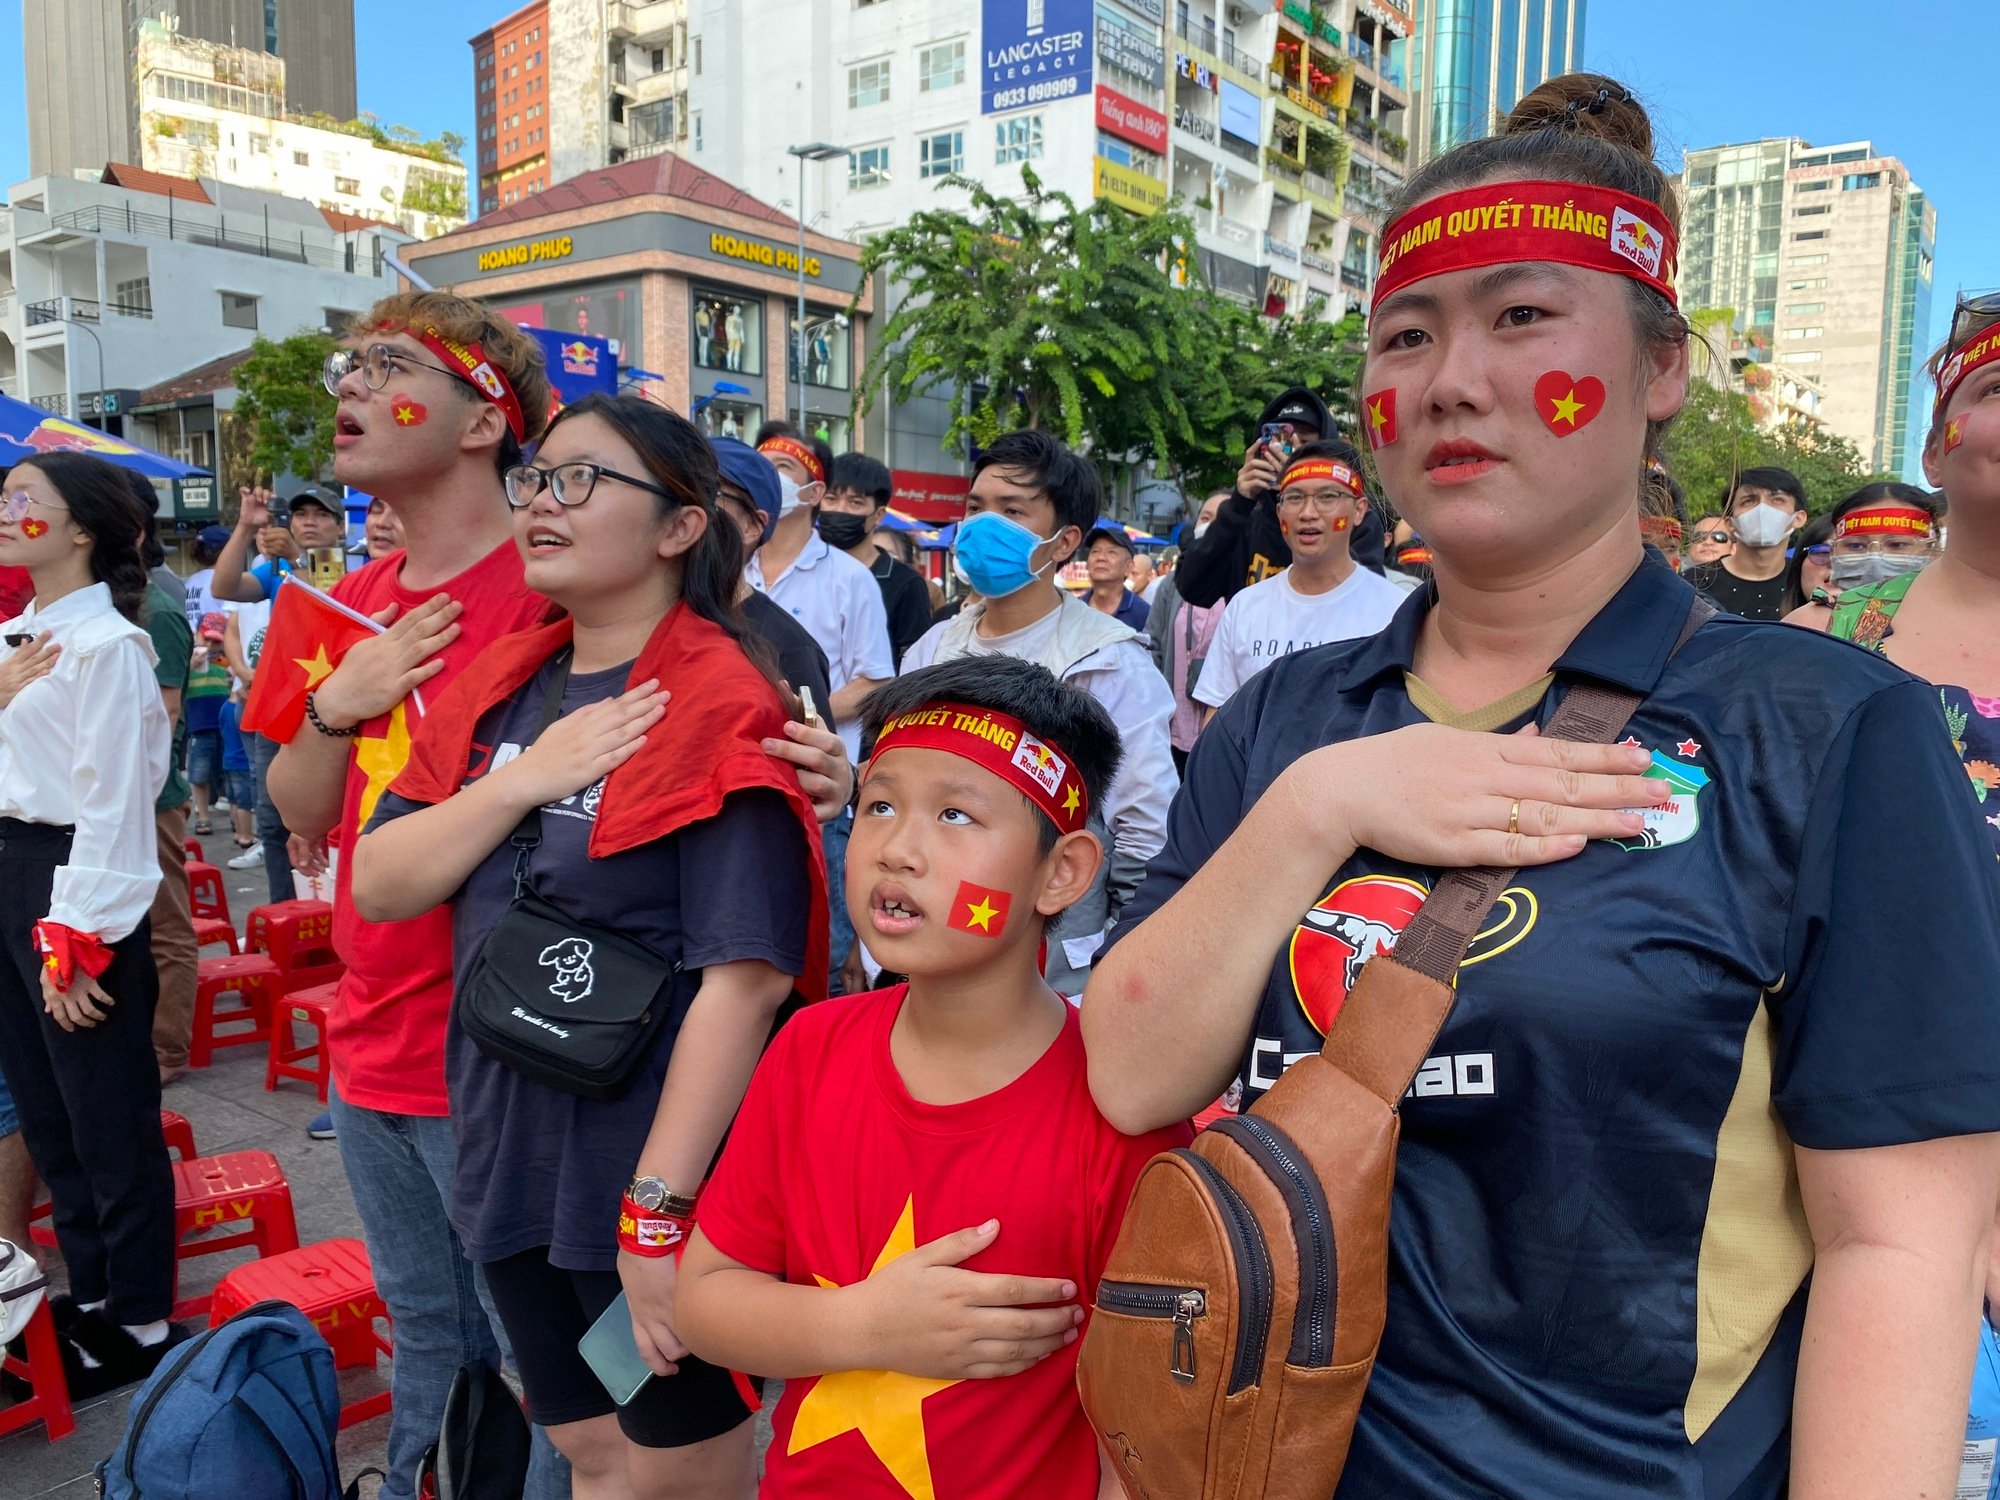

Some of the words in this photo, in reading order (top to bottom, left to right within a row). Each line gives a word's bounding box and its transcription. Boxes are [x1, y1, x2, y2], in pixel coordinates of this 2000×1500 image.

[987, 31, 1084, 69] LANCASTER
[993, 54, 1077, 82] LEGACY
[993, 86, 1026, 110] 0933
[1027, 76, 1078, 103] 090909
[1398, 215, 1443, 259] NAM
[1446, 198, 1525, 237] QUYẾT
[1529, 199, 1608, 240] THẮNG
[478, 243, 529, 271] HOANG
[530, 234, 573, 261] PHUC
[711, 231, 774, 268] HOANG
[1618, 238, 1638, 261] Red
[1636, 248, 1655, 274] Bull
[1859, 516, 1881, 527] NAM
[1882, 515, 1911, 528] QUYẾT
[897, 705, 953, 729] QUYẾT
[951, 713, 1018, 753] THẮNG
[1019, 754, 1039, 776] Red
[1036, 768, 1054, 790] Bull
